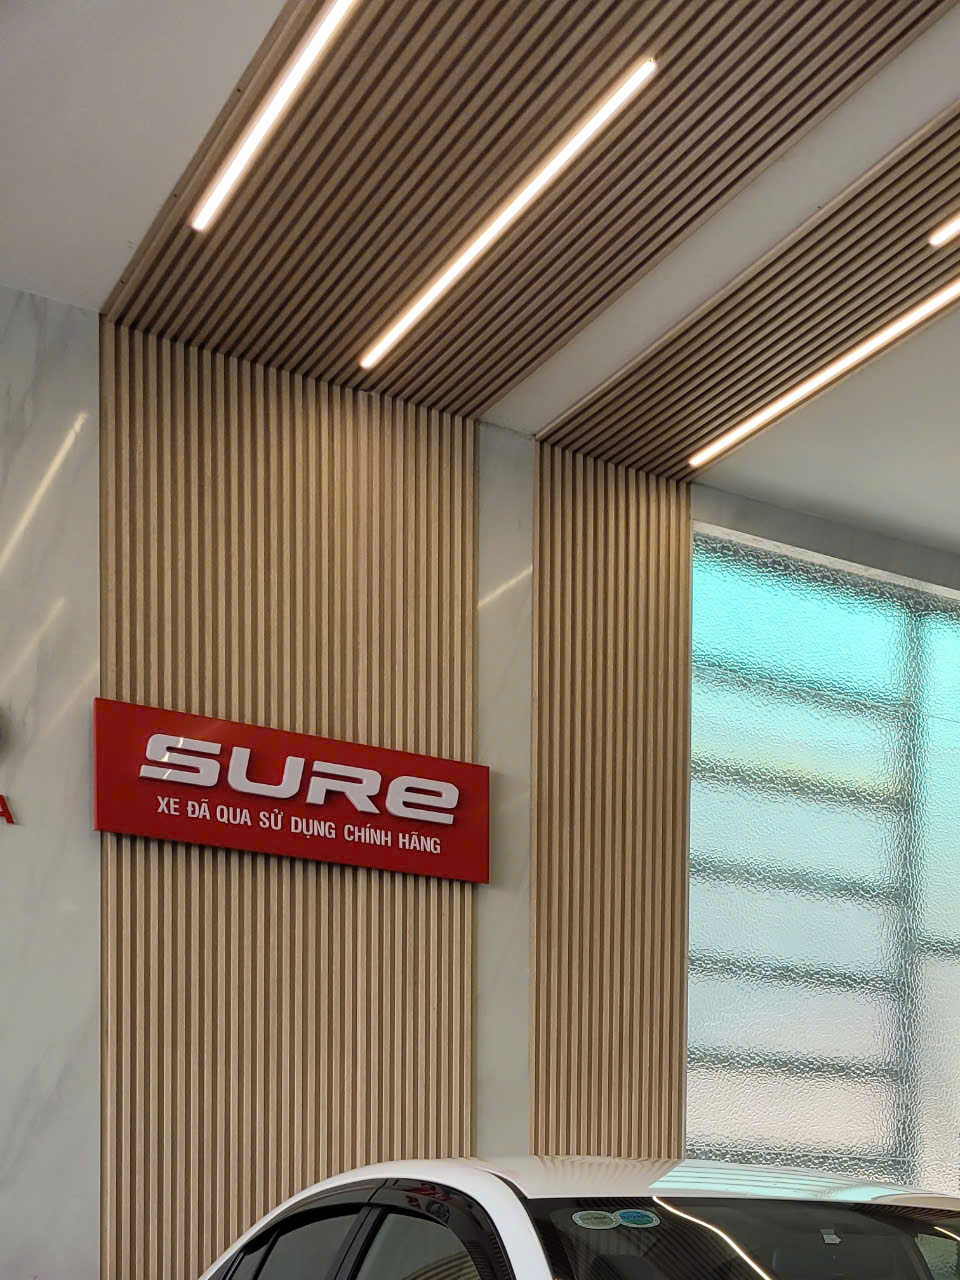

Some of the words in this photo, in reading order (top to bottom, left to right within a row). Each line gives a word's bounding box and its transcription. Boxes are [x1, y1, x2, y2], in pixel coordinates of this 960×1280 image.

[157, 795, 180, 816] XE
[187, 799, 211, 820] ĐÃ
[216, 805, 252, 826] QUA
[259, 808, 284, 831] SỬ
[291, 816, 336, 839] DỤNG
[344, 823, 392, 847] CHÍNH
[398, 831, 441, 854] HÃNG
